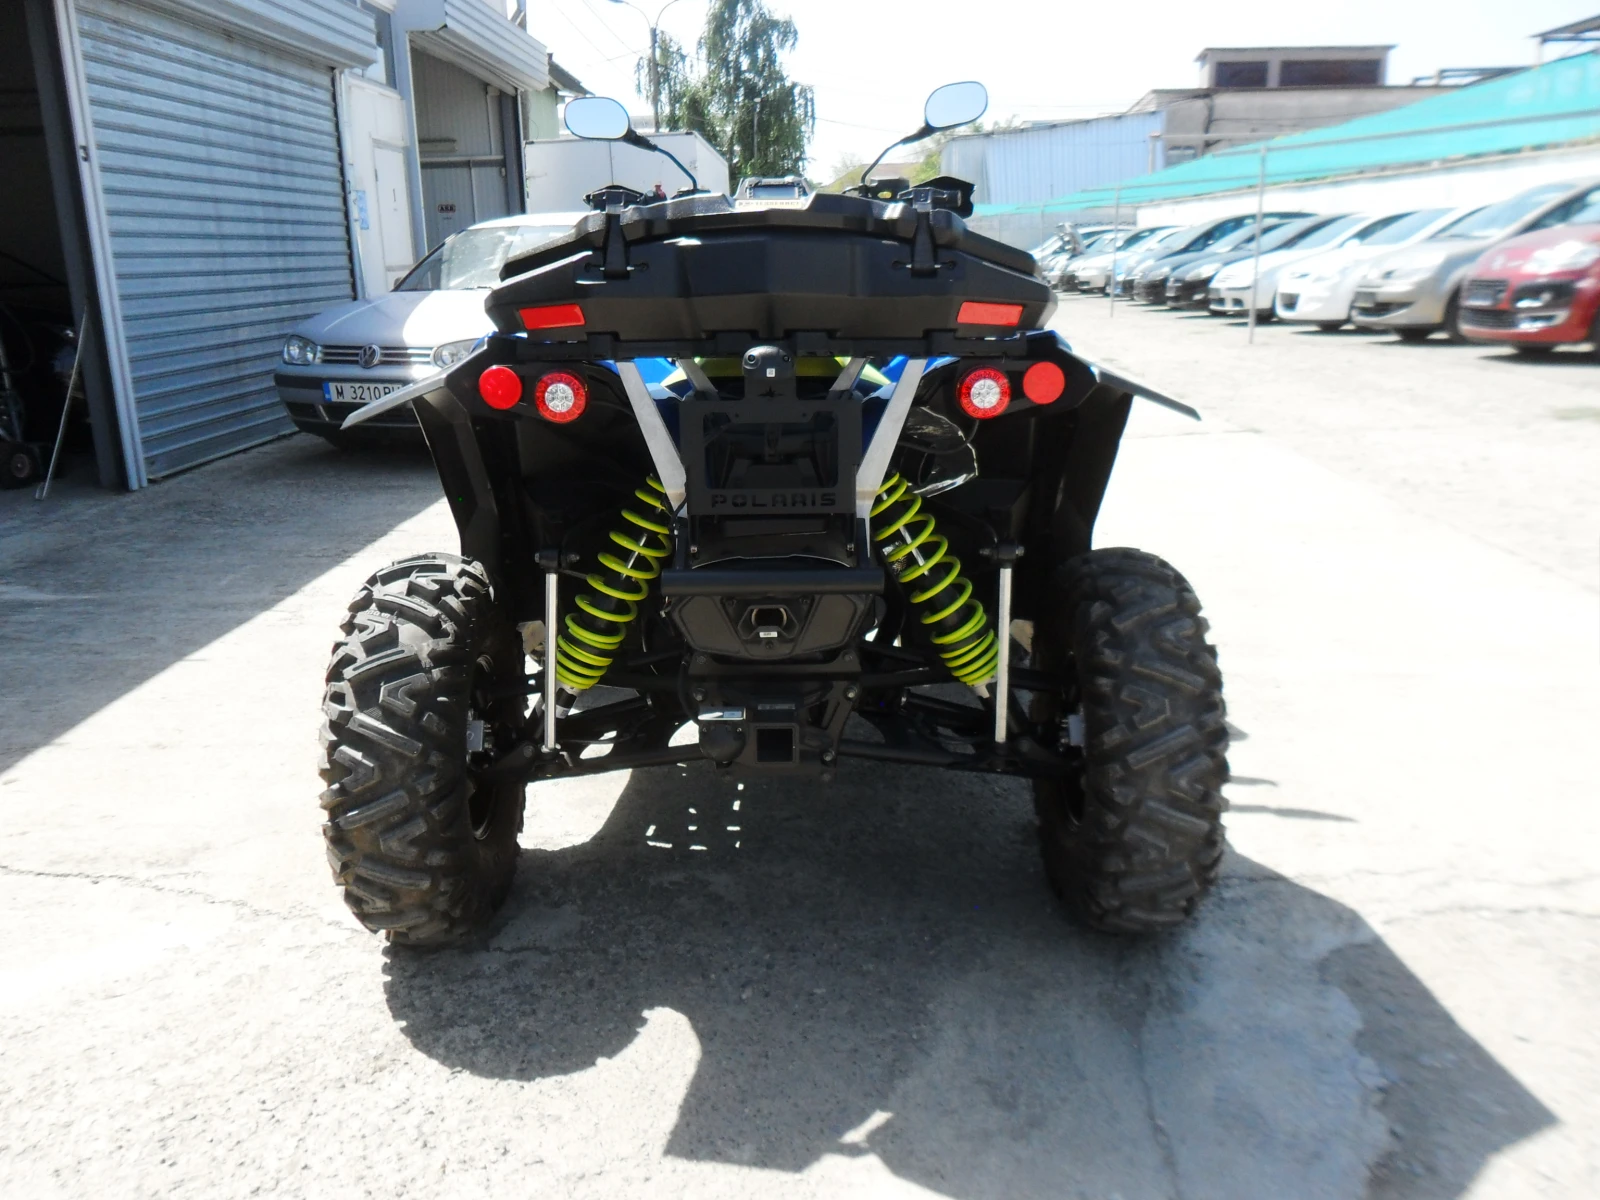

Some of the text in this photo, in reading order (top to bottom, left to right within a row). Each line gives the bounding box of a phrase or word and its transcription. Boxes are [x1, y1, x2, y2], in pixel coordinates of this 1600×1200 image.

[335, 385, 345, 400] M
[350, 386, 381, 400] 3210
[711, 492, 836, 508] POLARIS
